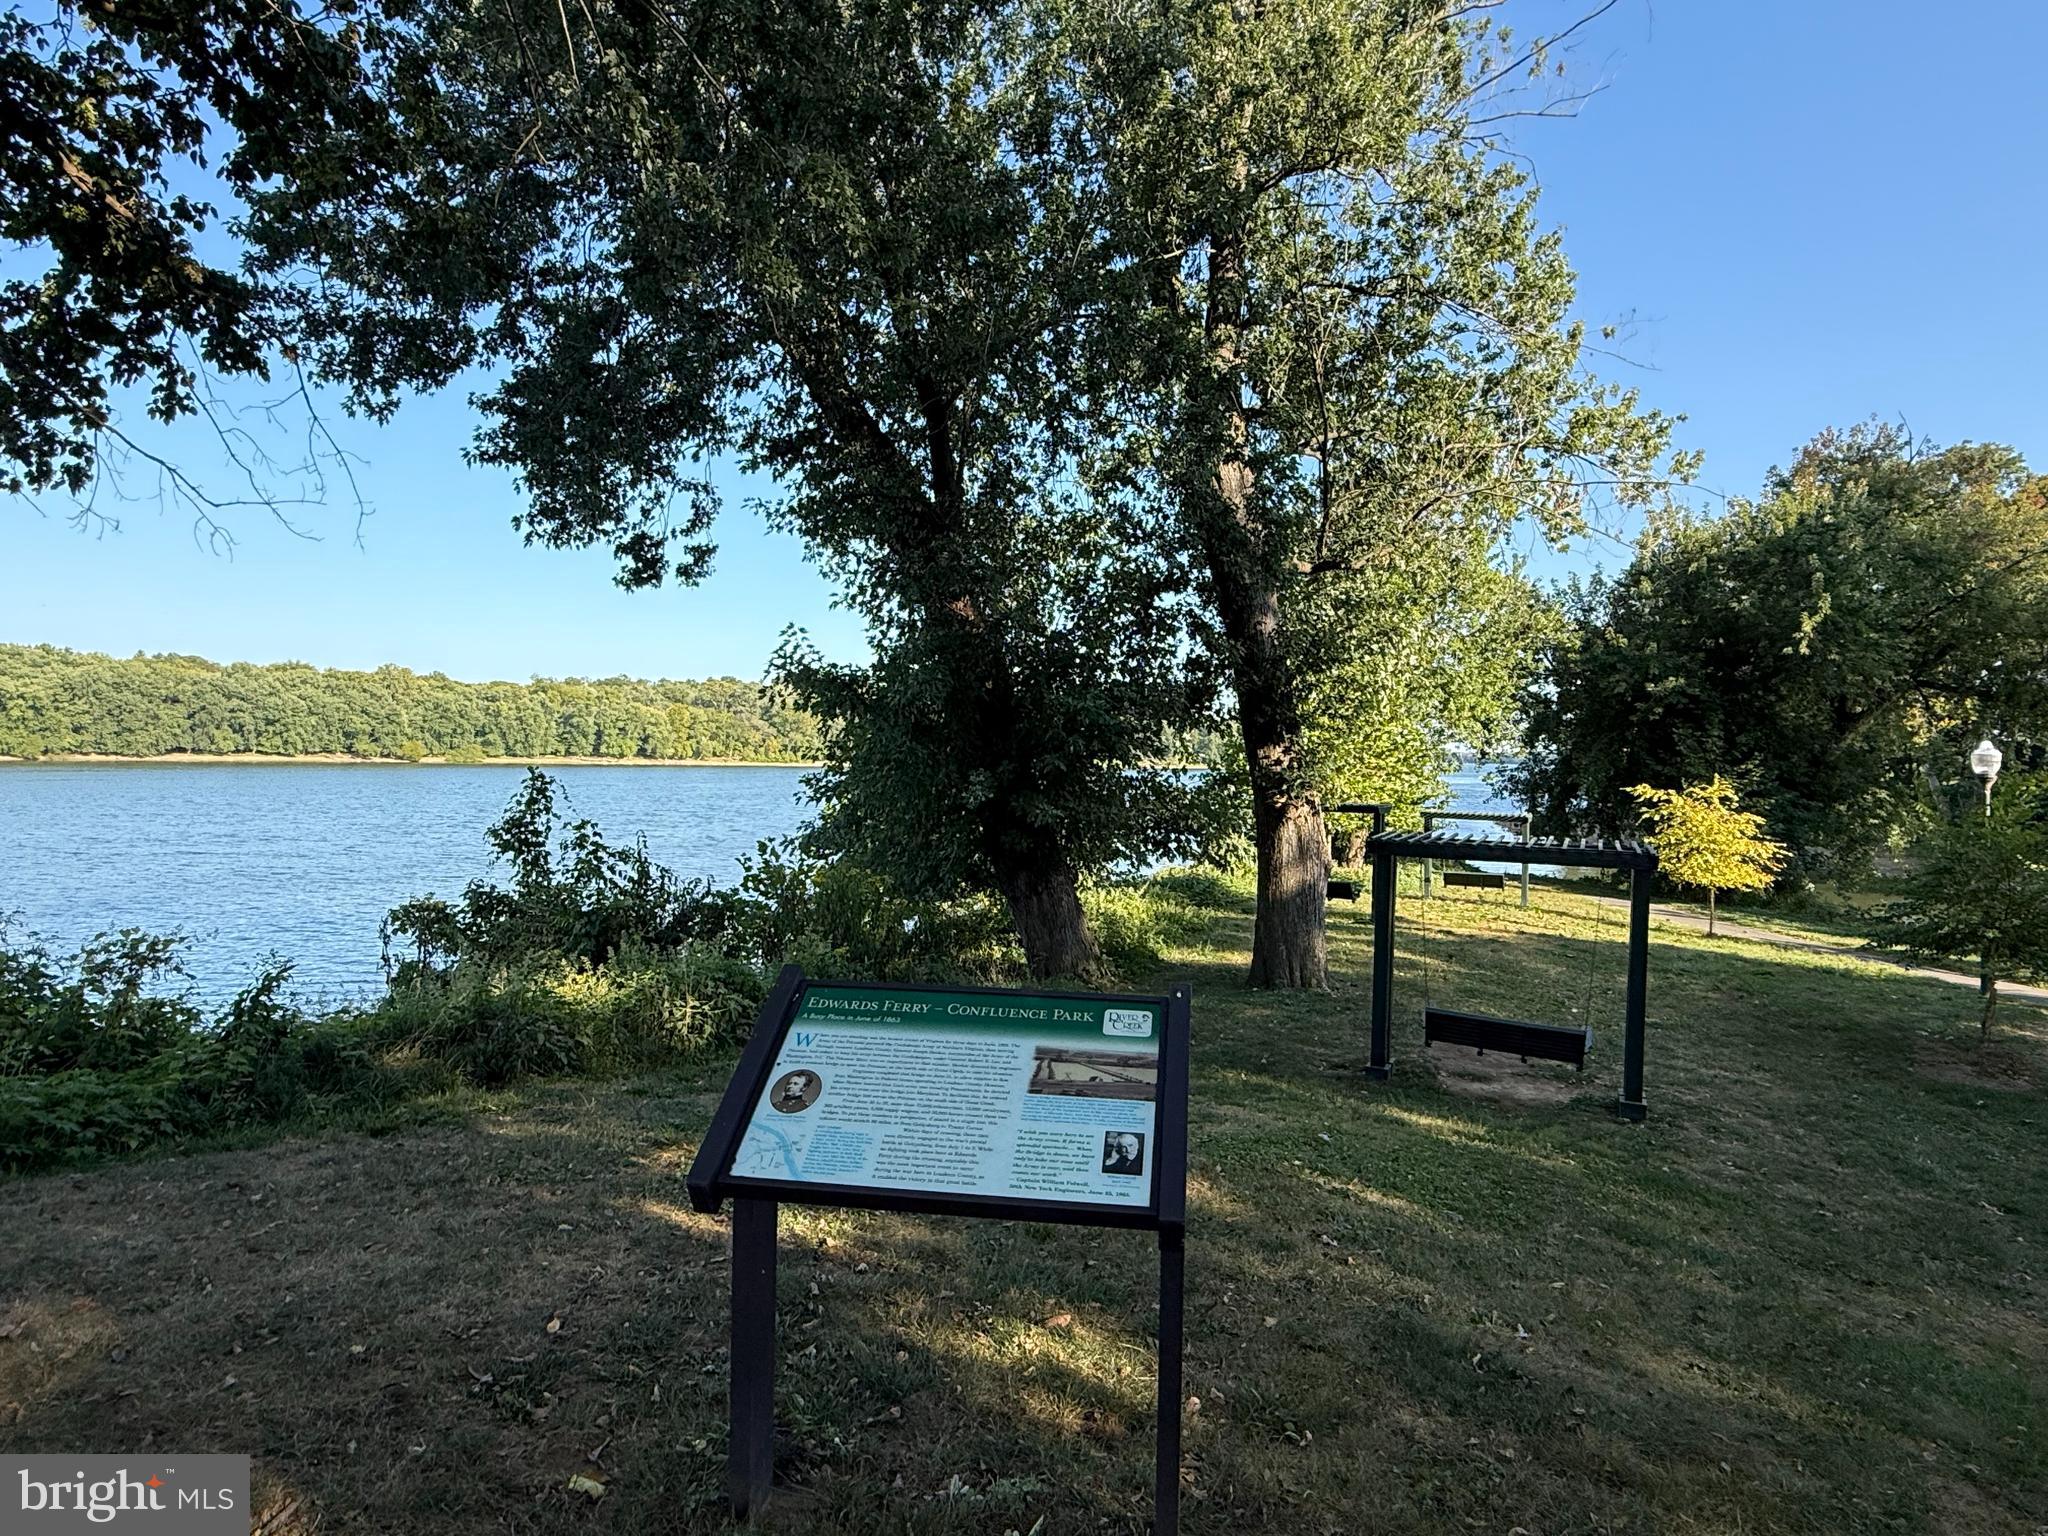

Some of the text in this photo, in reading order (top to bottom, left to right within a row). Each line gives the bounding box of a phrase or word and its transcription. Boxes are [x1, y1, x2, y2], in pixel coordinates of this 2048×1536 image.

[808, 996, 879, 1011] EDWARDS
[882, 1000, 932, 1013] FERRY
[947, 1003, 1048, 1020] CONFLUENCE
[1052, 1008, 1094, 1022] PARK
[1108, 1012, 1140, 1023] RIVER
